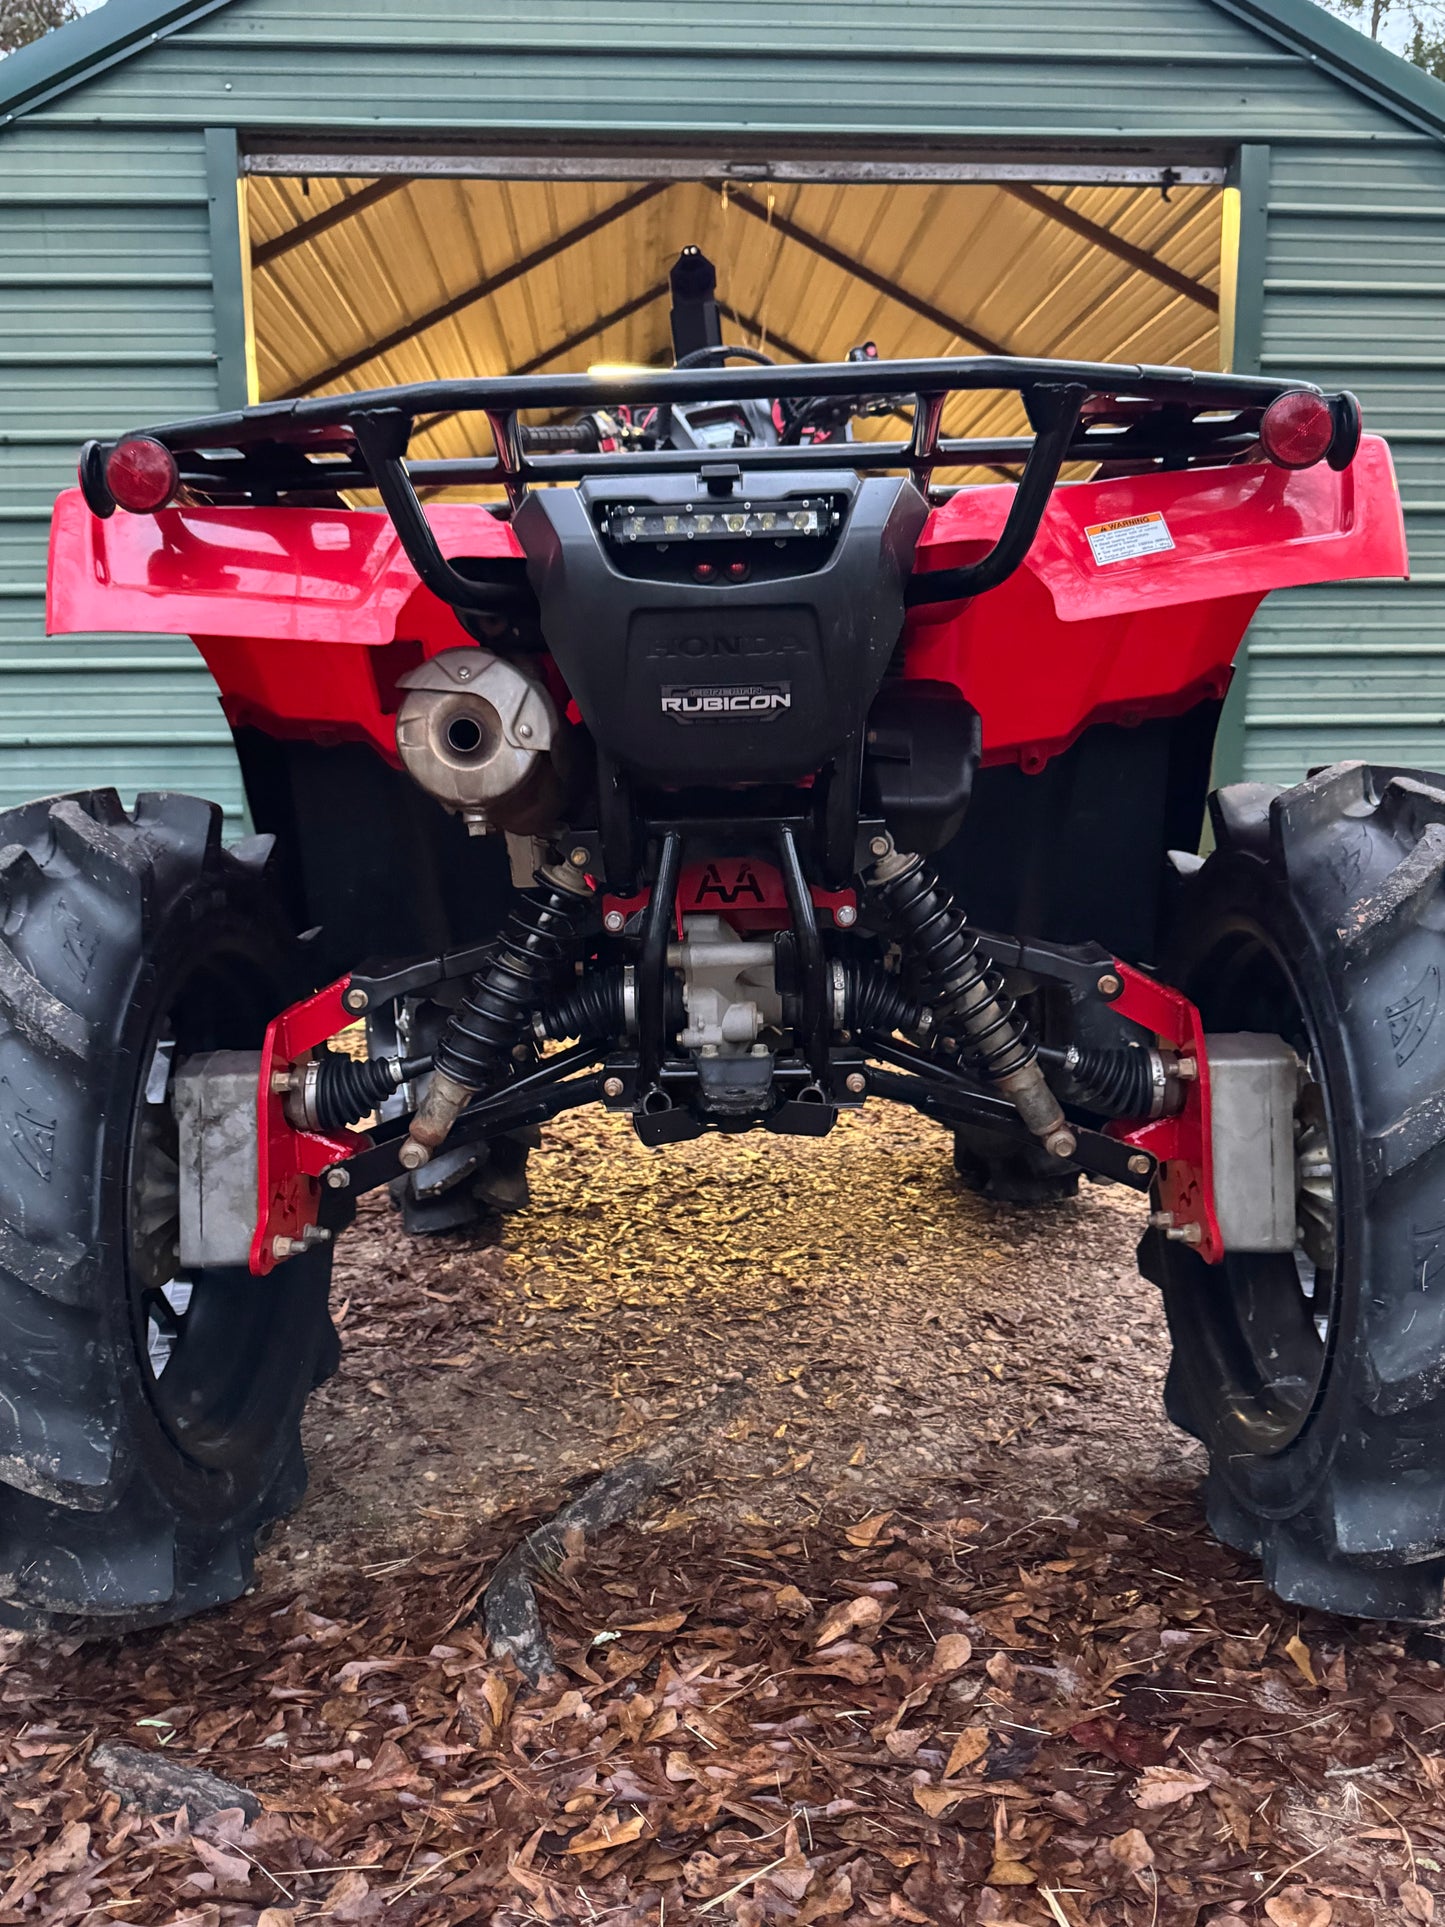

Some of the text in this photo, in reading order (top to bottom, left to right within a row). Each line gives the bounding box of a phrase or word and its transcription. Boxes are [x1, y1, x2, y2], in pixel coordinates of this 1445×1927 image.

[1108, 516, 1150, 530] WARNING
[646, 636, 809, 658] HONDA
[661, 693, 791, 711] RUBICON
